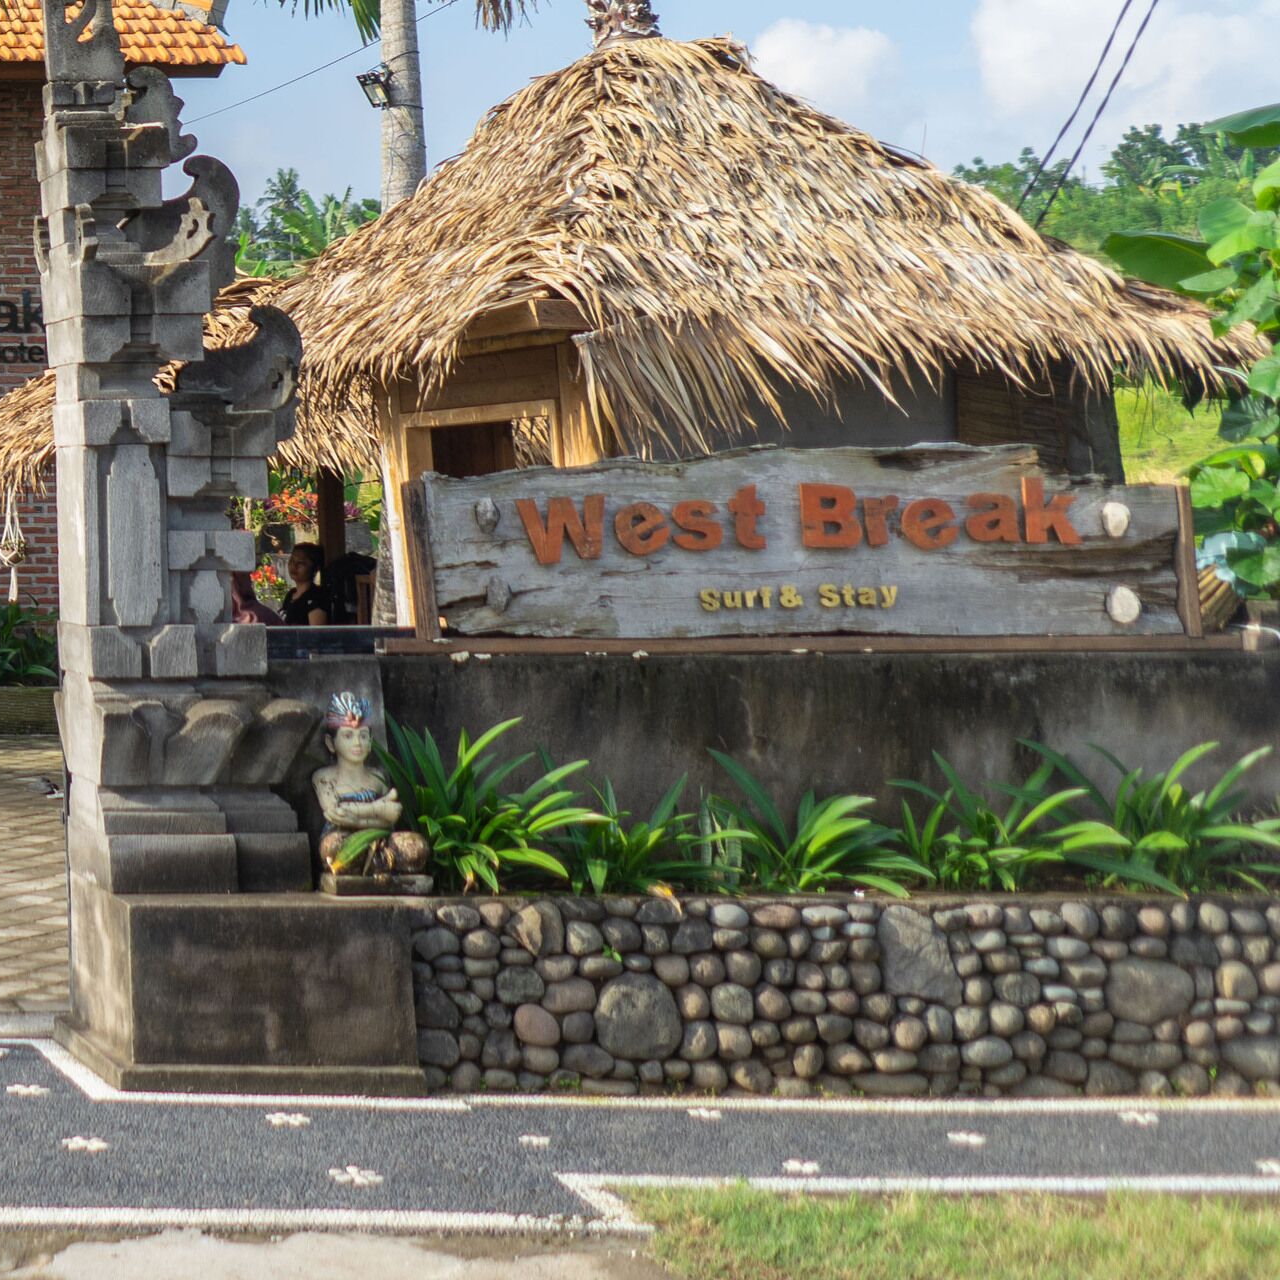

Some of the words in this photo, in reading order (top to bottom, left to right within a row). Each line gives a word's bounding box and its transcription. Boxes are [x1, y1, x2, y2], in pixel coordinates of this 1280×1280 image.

[515, 484, 766, 564] West
[799, 477, 1084, 551] Break
[698, 586, 772, 612] Surf
[817, 583, 898, 609] Stay
